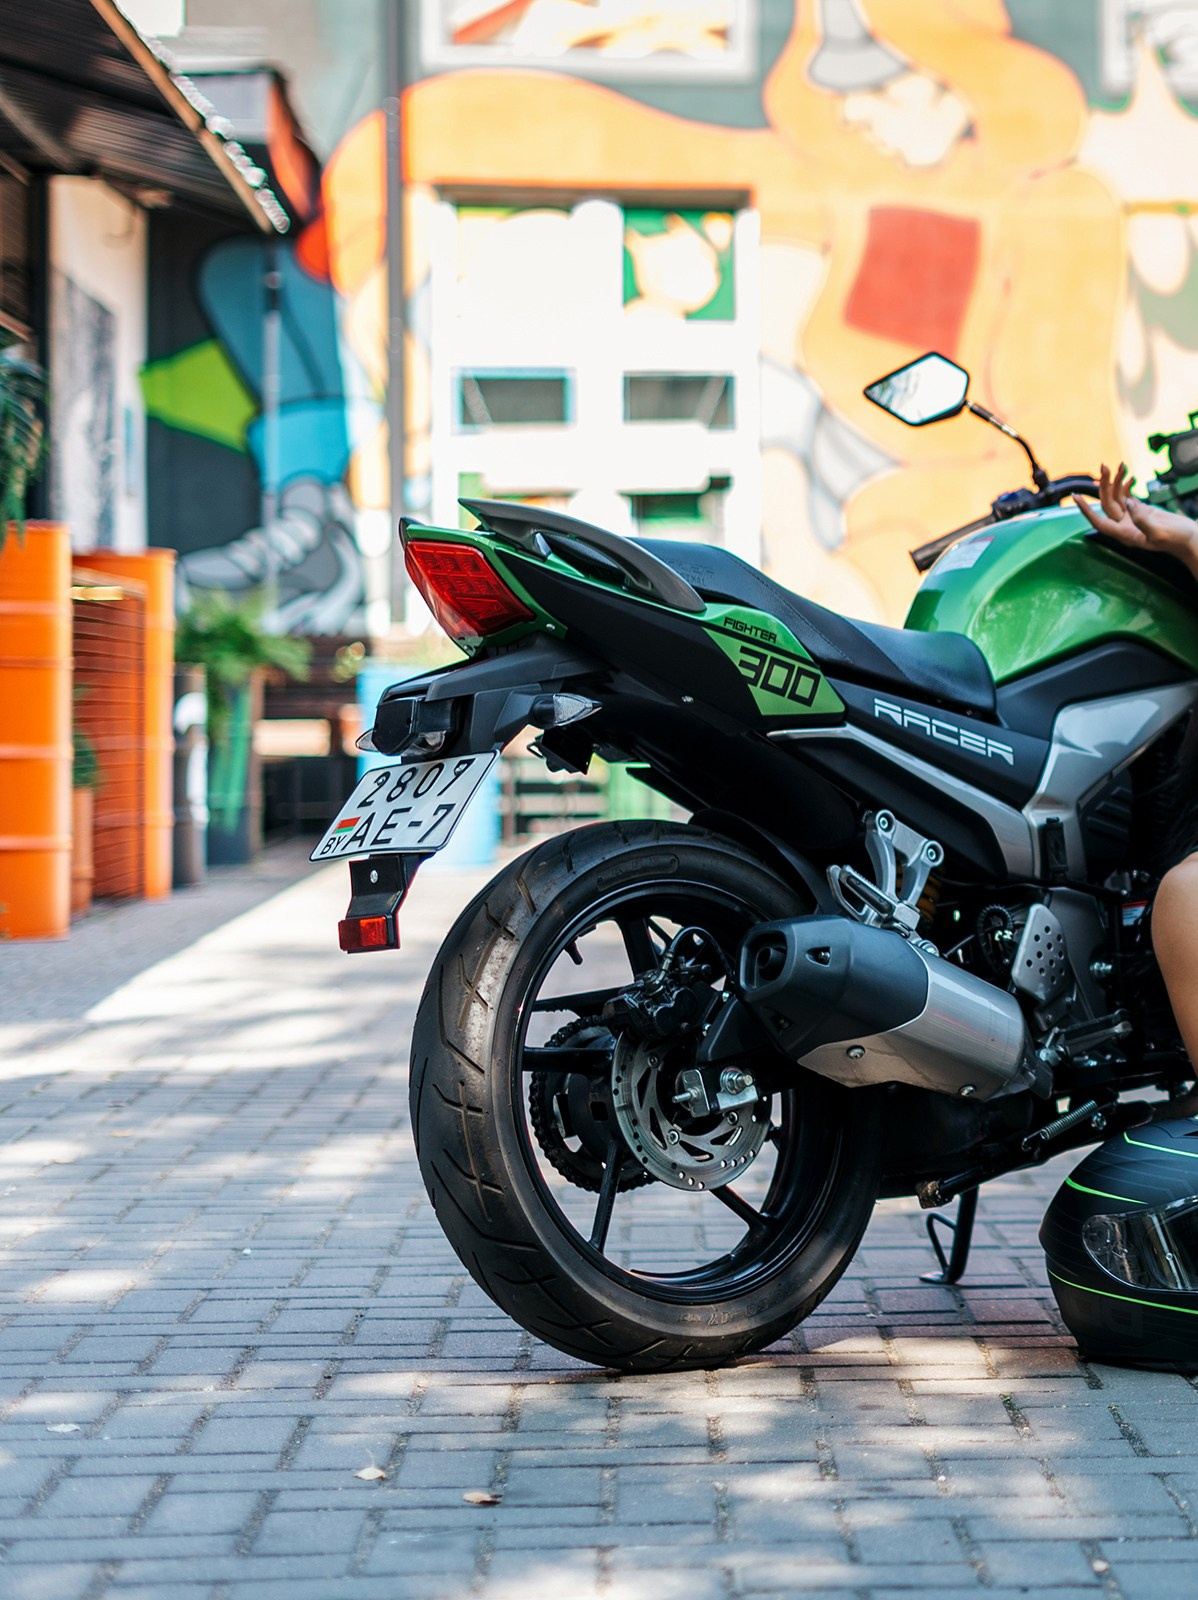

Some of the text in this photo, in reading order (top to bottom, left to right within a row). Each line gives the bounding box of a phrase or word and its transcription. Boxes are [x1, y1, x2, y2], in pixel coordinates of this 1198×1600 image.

[723, 617, 777, 644] FIGHTER
[738, 645, 822, 707] 300
[874, 698, 1014, 766] RACER
[320, 803, 456, 855] BY AE-7
